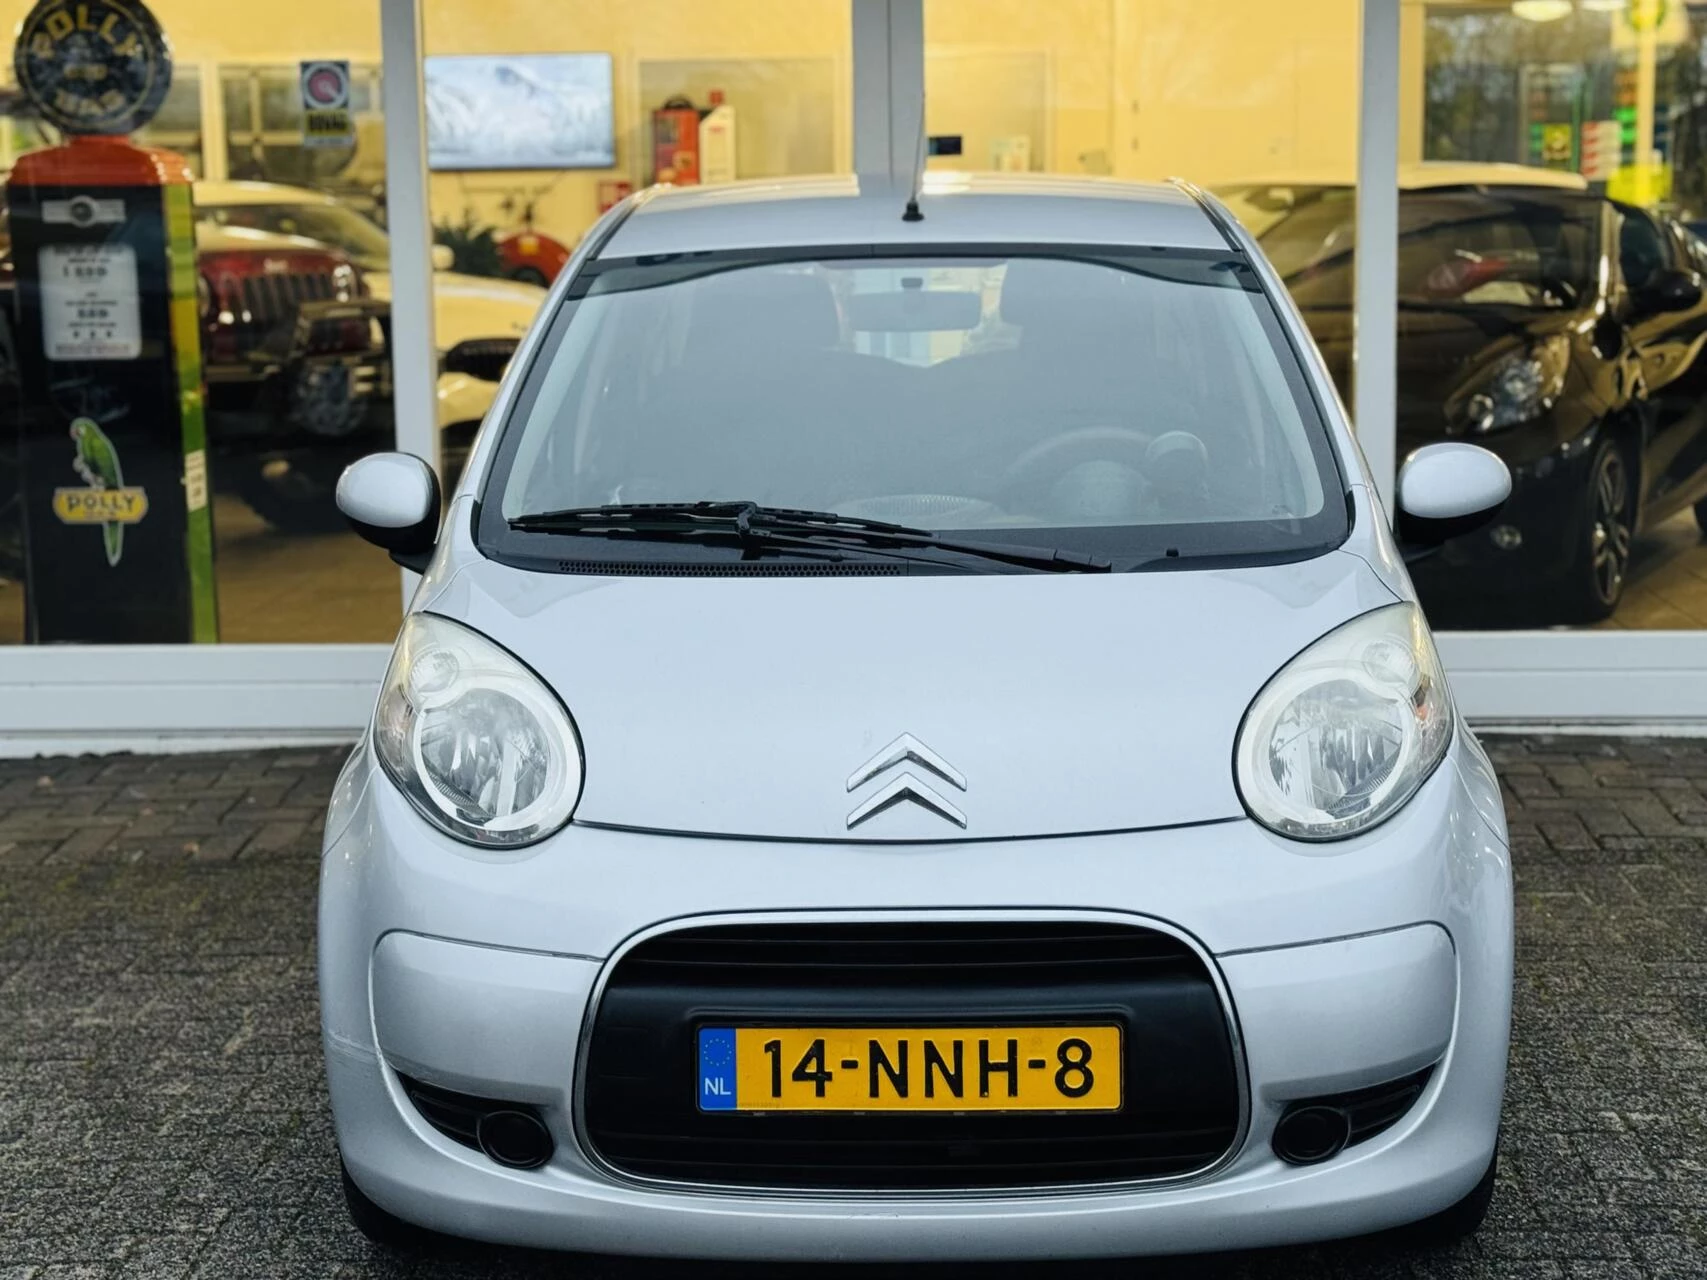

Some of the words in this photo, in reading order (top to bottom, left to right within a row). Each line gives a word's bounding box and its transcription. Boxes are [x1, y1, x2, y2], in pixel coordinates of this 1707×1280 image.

[67, 494, 134, 513] POLLY
[764, 1038, 1095, 1098] 14-NNH-8
[704, 1077, 732, 1096] NL
